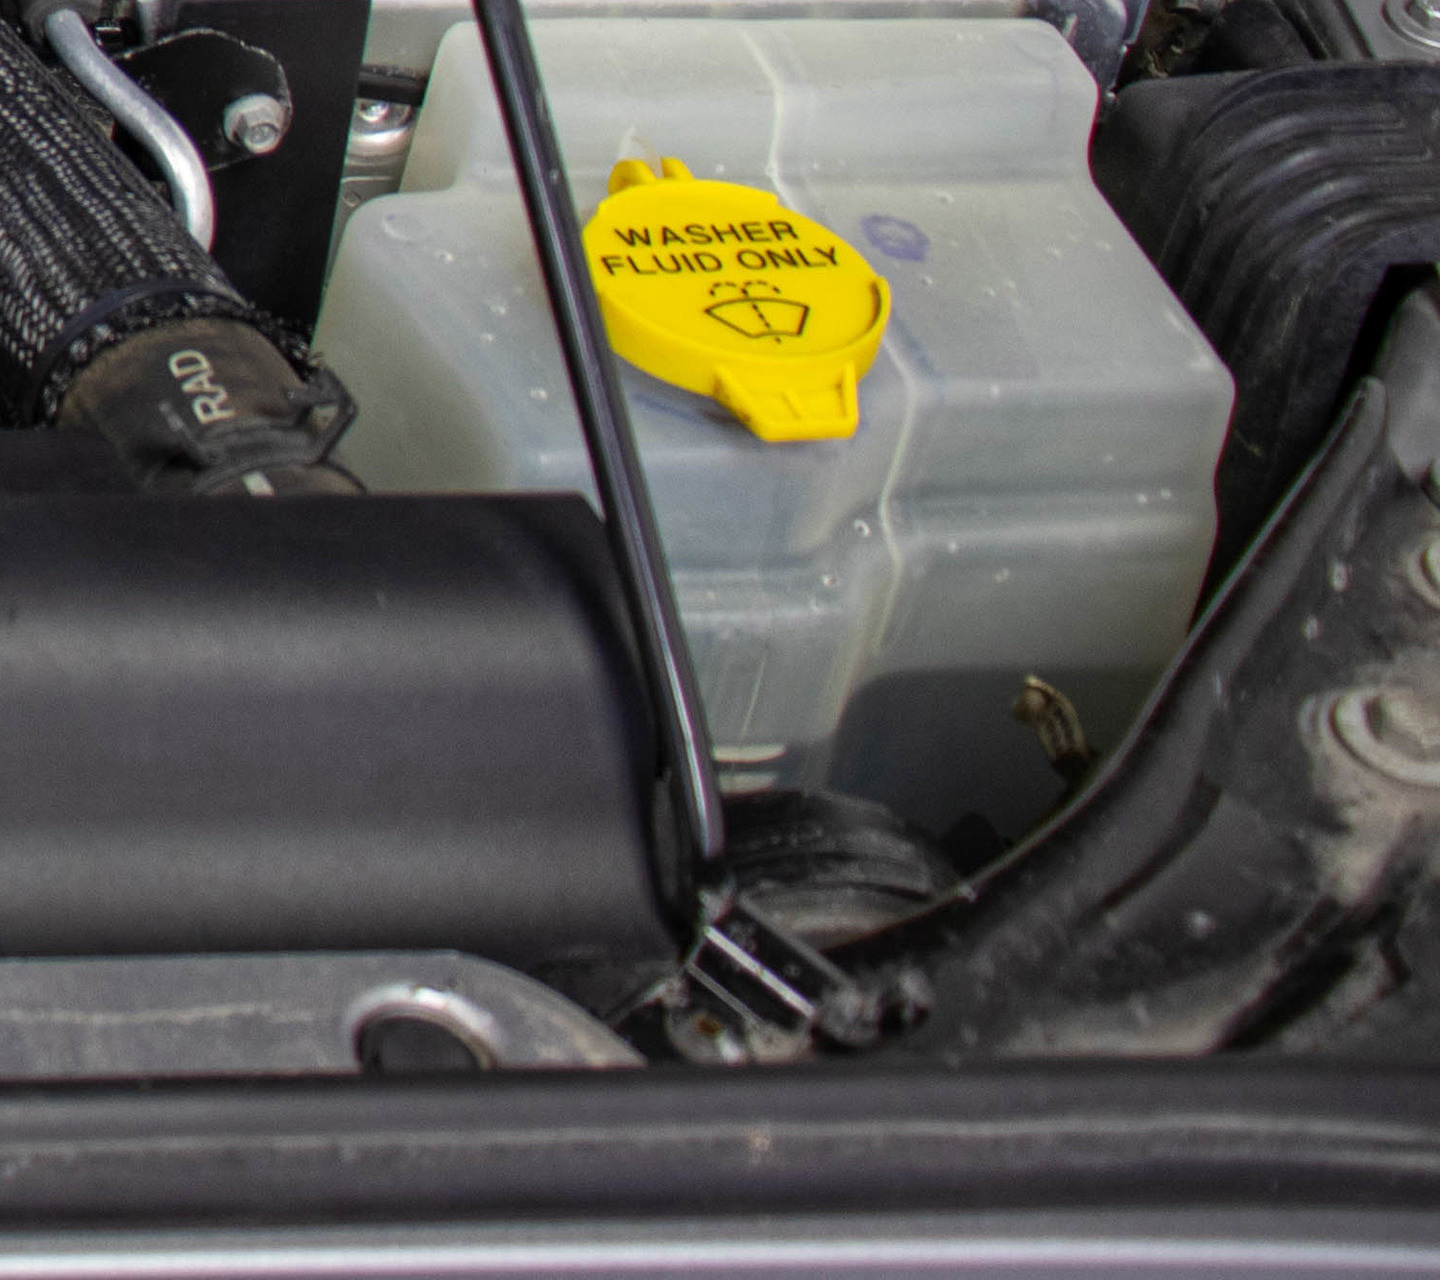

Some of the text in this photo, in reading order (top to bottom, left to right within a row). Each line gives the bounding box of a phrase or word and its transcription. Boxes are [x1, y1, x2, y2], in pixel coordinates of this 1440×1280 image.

[614, 220, 799, 247] WASHER
[600, 246, 839, 276] FLUID ONLY
[168, 349, 236, 425] RAD
